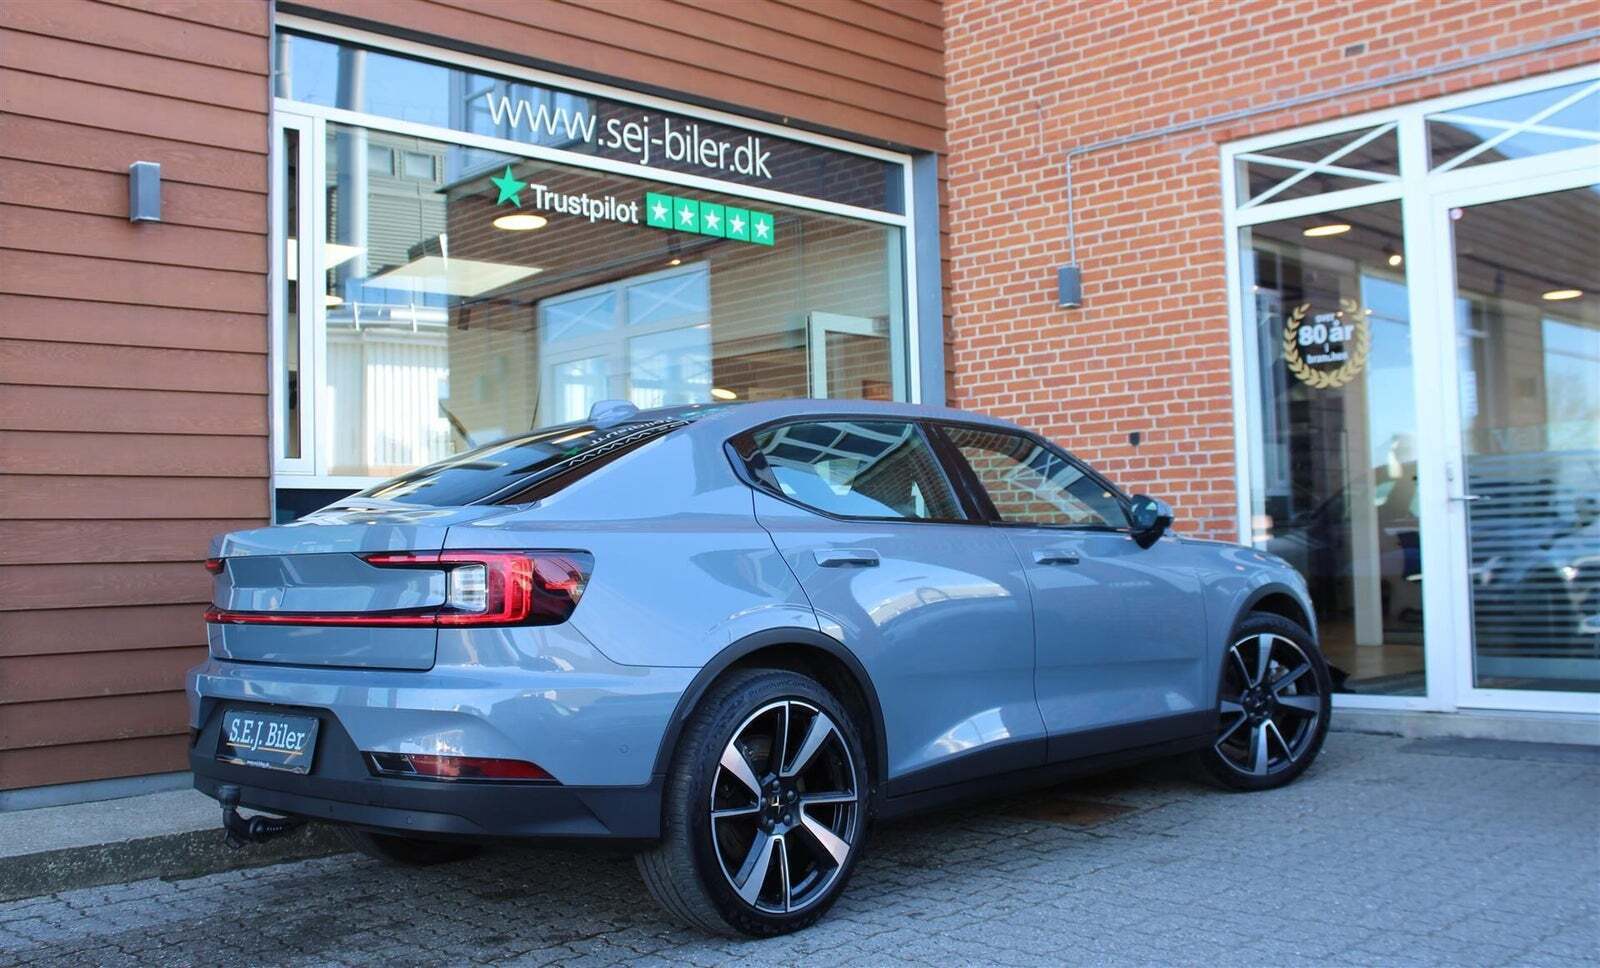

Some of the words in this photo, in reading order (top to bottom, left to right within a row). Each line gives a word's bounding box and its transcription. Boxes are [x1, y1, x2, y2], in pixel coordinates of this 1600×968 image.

[487, 93, 772, 179] www.sej-biler.dk
[530, 183, 639, 224] Trustpilot
[1299, 324, 1328, 346] 80
[1328, 319, 1354, 342] år
[229, 718, 263, 751] S.E.J.
[265, 722, 306, 750] Biler
